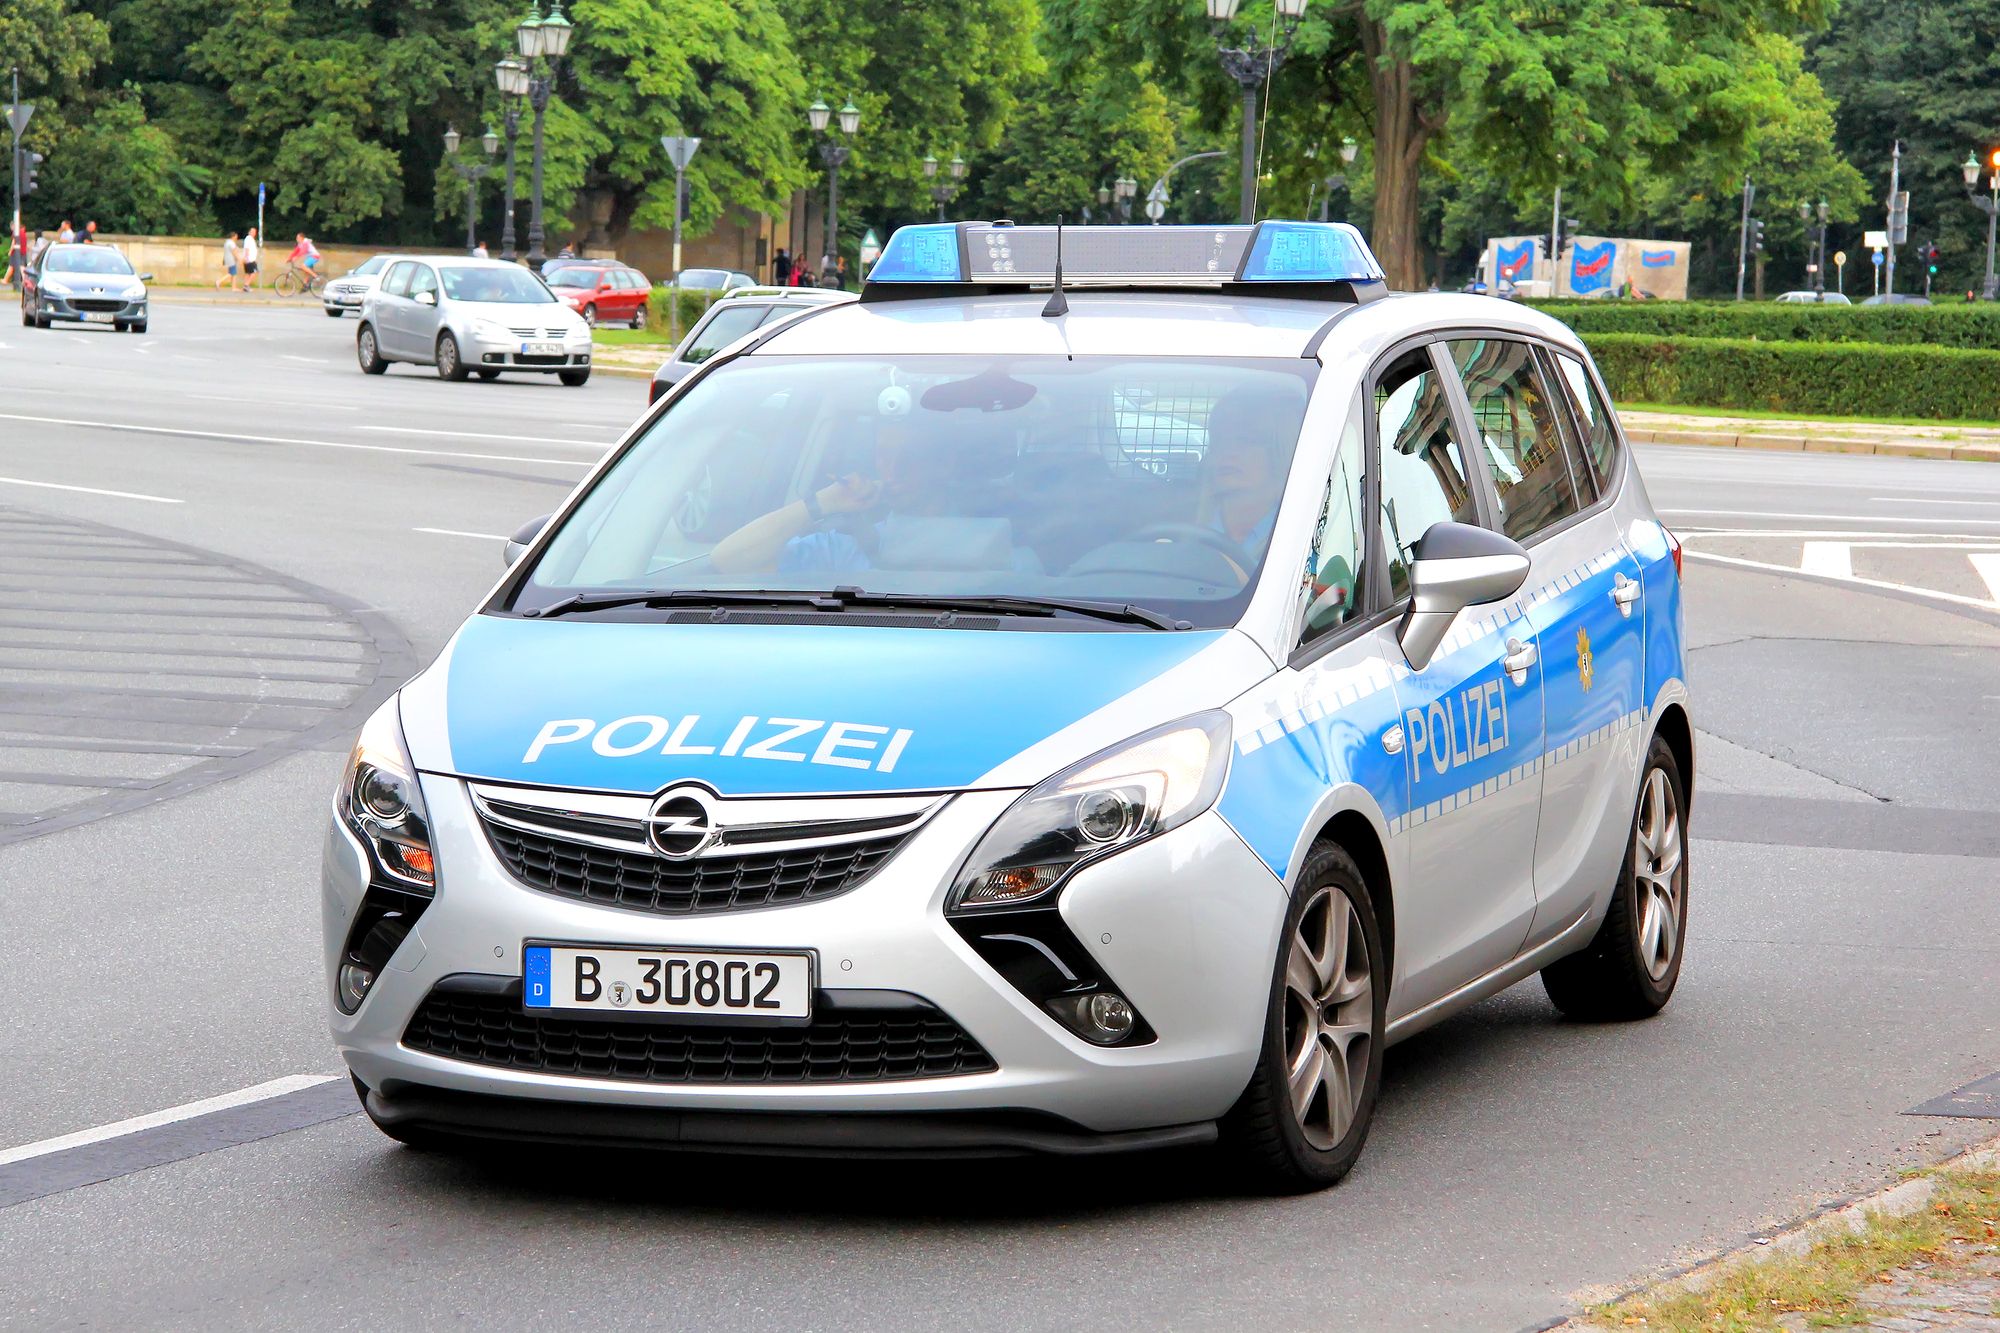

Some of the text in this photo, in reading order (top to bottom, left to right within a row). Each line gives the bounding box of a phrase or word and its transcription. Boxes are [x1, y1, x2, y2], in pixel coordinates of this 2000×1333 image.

[521, 714, 915, 774] POLIZEI
[1406, 677, 1510, 784] POLIZEI
[533, 983, 543, 997] D
[575, 955, 602, 1002] B
[635, 958, 781, 1009] 30802
